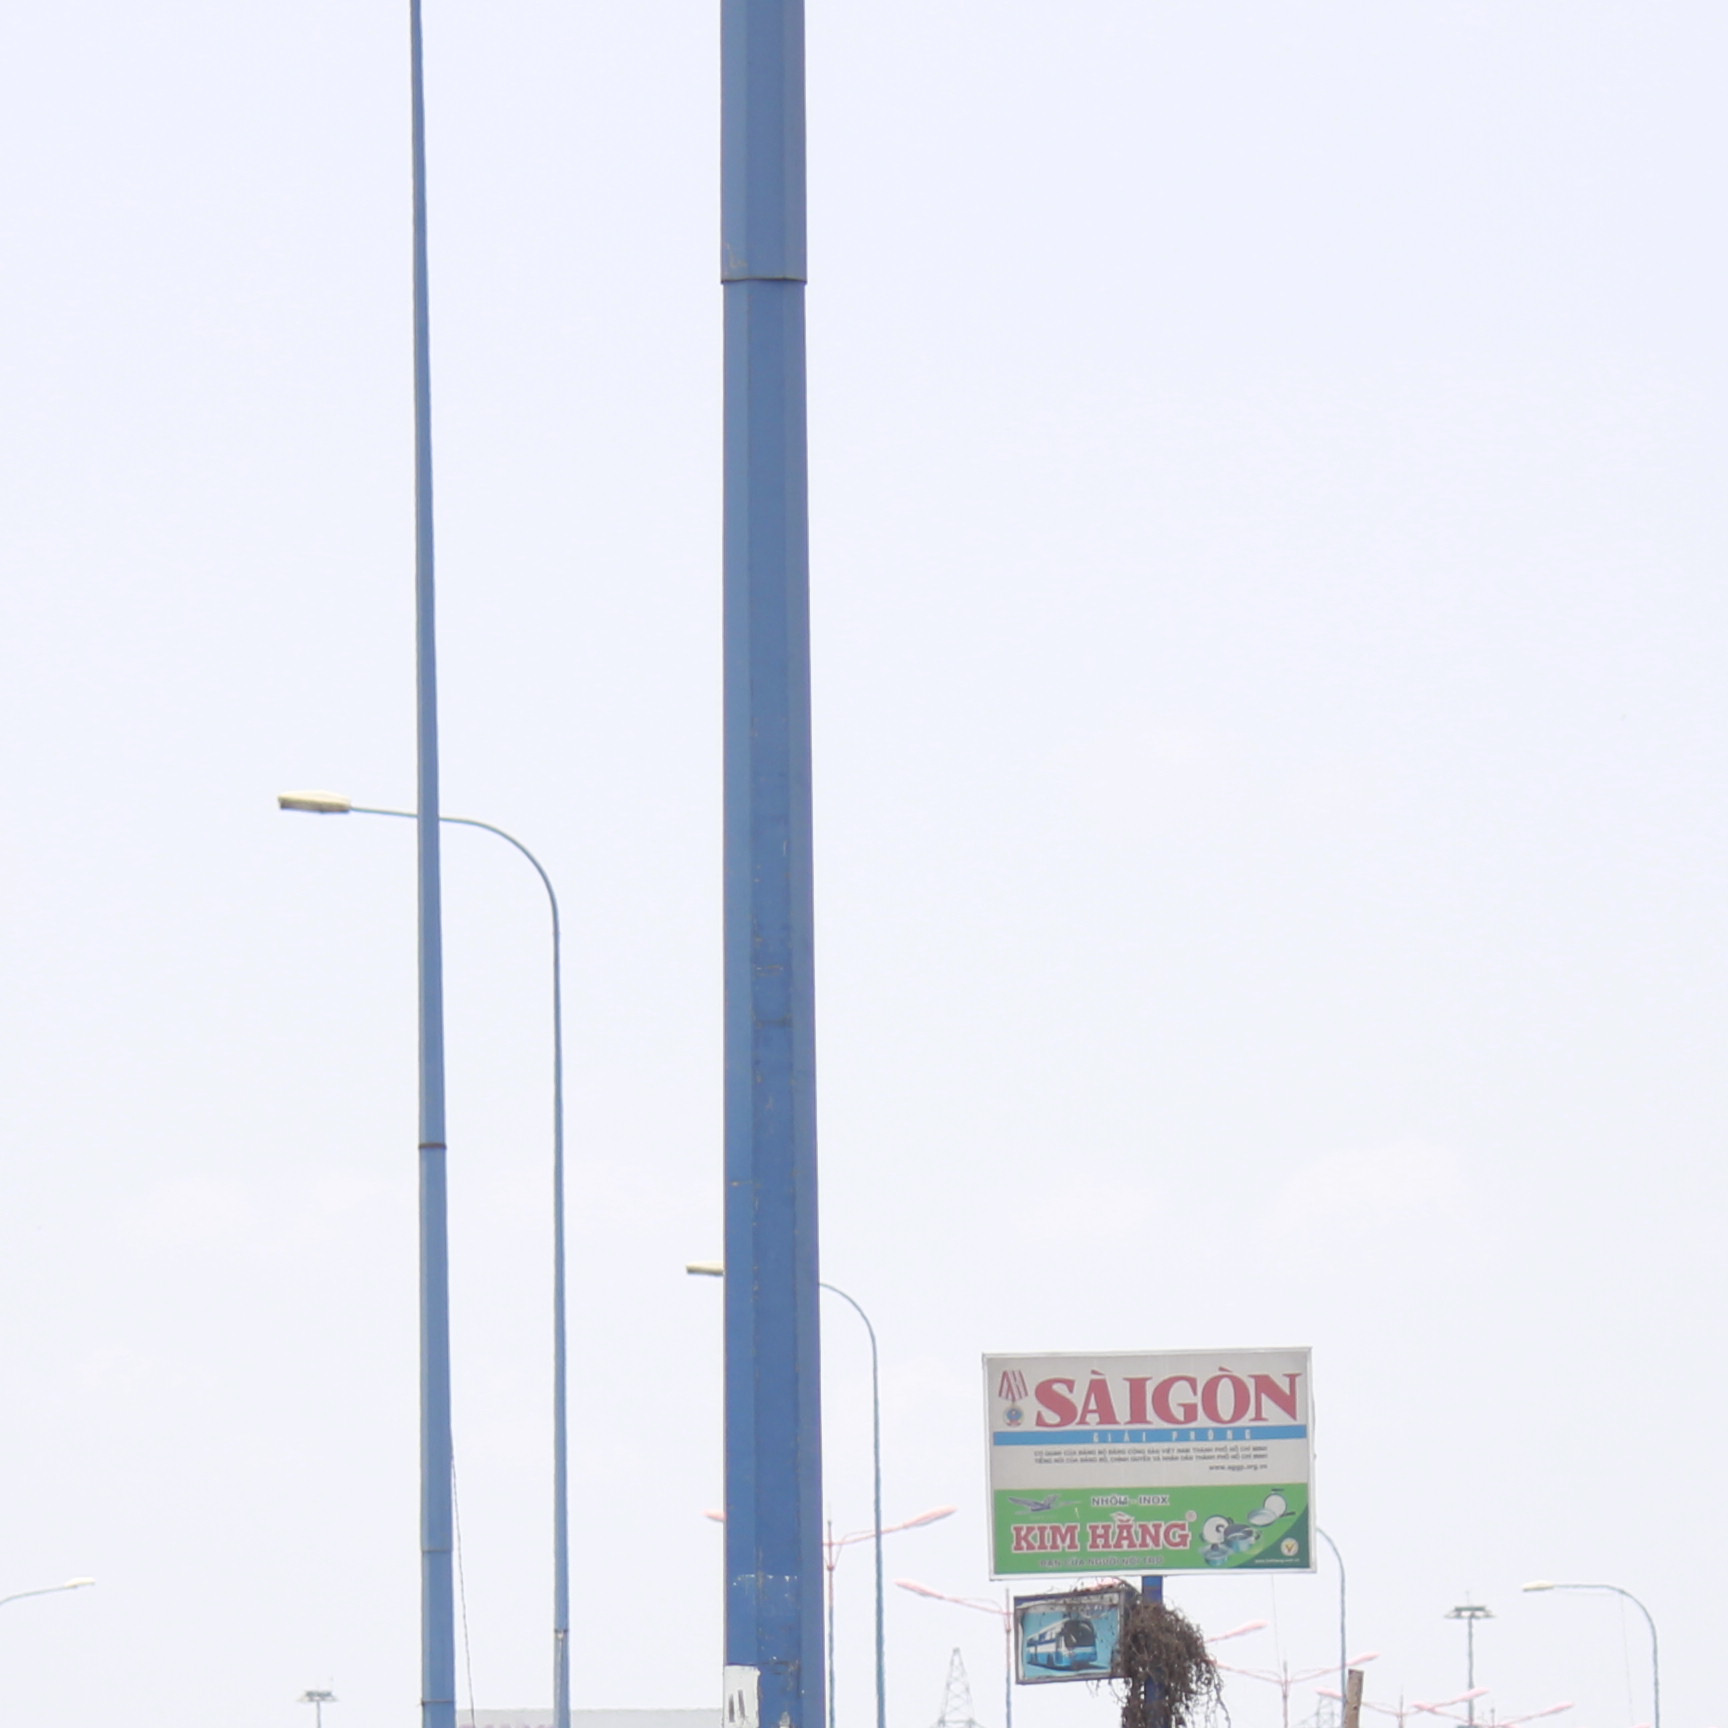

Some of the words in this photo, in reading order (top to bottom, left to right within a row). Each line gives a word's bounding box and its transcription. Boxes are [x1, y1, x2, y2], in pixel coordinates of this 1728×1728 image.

[1034, 1366, 1302, 1428] SÀIGÒN
[1138, 1495, 1170, 1505] INOX
[1012, 1523, 1080, 1552] KIM
